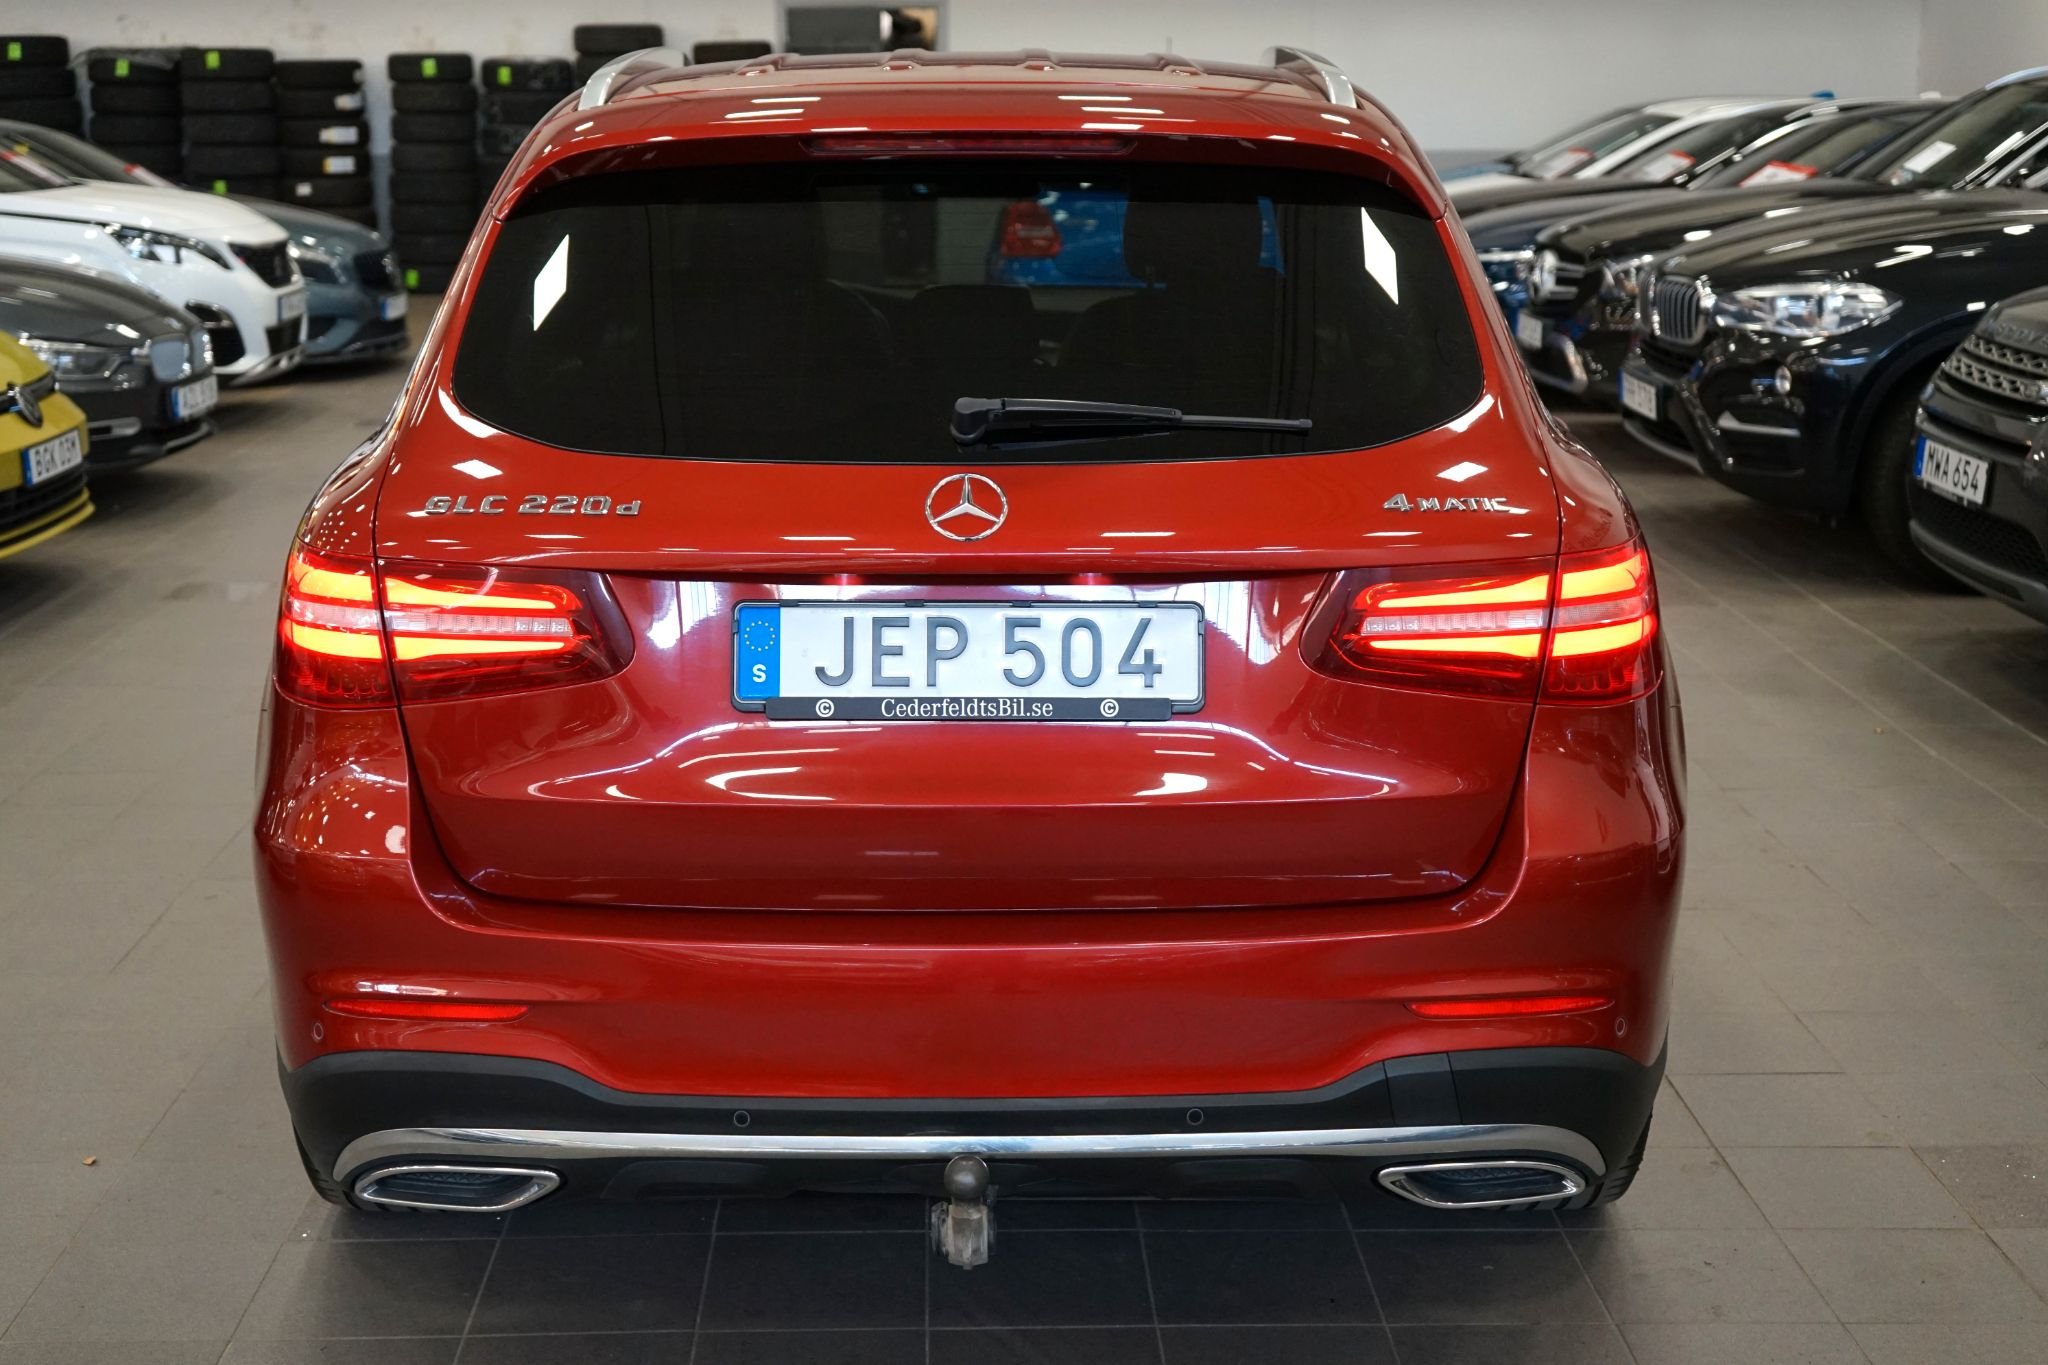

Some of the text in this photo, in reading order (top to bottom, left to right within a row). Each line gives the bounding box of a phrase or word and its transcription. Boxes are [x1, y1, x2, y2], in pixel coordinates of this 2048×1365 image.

[1925, 444, 1980, 496] MWA 654
[424, 495, 508, 514] GLC
[815, 616, 1163, 688] JEP 504
[752, 663, 767, 683] S
[881, 698, 1054, 718] CederfeldtsBil.se
